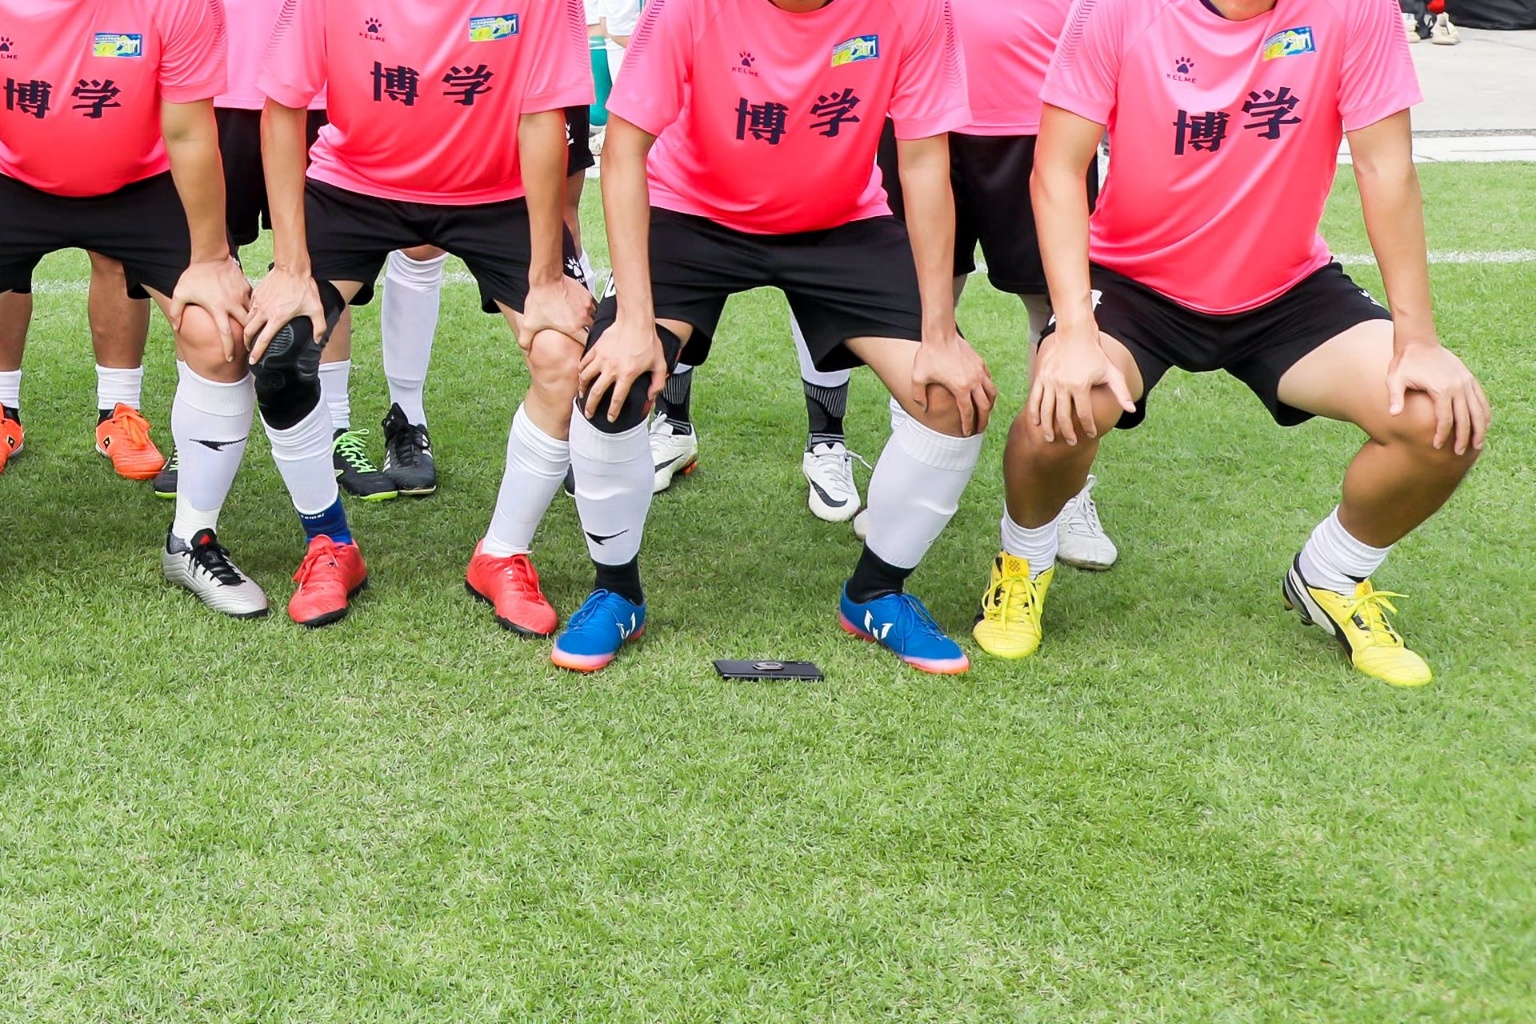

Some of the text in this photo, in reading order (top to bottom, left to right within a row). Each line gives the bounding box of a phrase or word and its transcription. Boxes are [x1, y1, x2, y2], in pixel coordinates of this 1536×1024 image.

[3, 78, 121, 119] 博学
[370, 61, 494, 106] 博学
[735, 88, 861, 146] 博学
[1173, 86, 1302, 156] 博学
